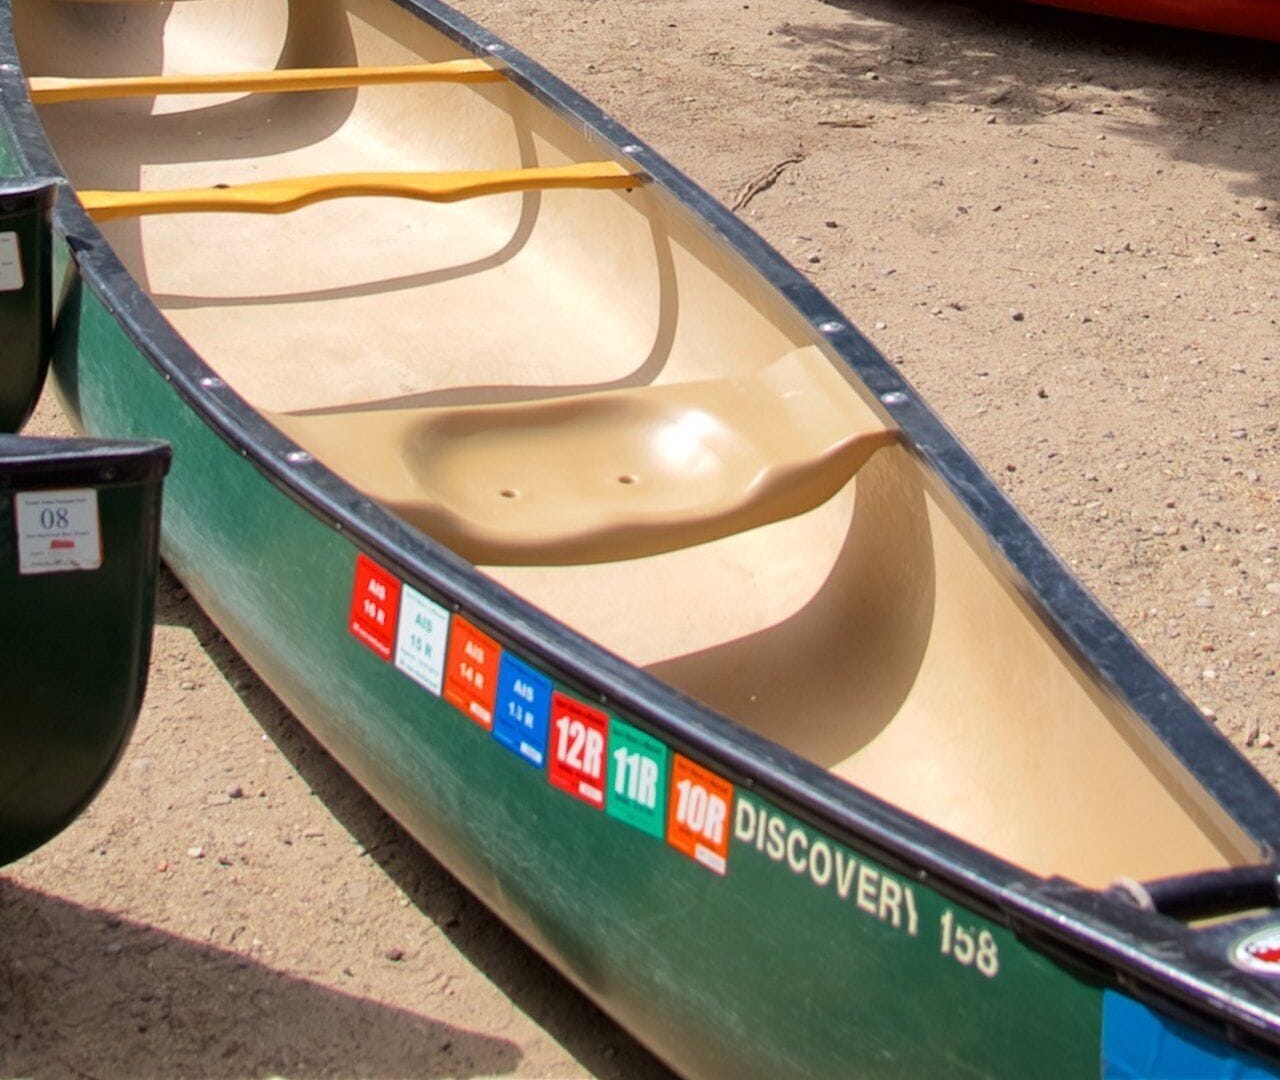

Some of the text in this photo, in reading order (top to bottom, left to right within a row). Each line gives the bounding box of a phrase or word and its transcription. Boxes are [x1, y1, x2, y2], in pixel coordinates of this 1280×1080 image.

[39, 506, 71, 531] 08
[368, 579, 387, 601] AIS
[415, 612, 433, 634] AIS
[464, 639, 485, 664] AIS
[459, 661, 485, 690] 14 R
[513, 679, 535, 703] AIS
[523, 711, 535, 729] R
[555, 715, 605, 780] 12R
[612, 745, 660, 810] 11R
[676, 778, 728, 846] 10R
[733, 797, 1000, 978] DISCOVERY 158
